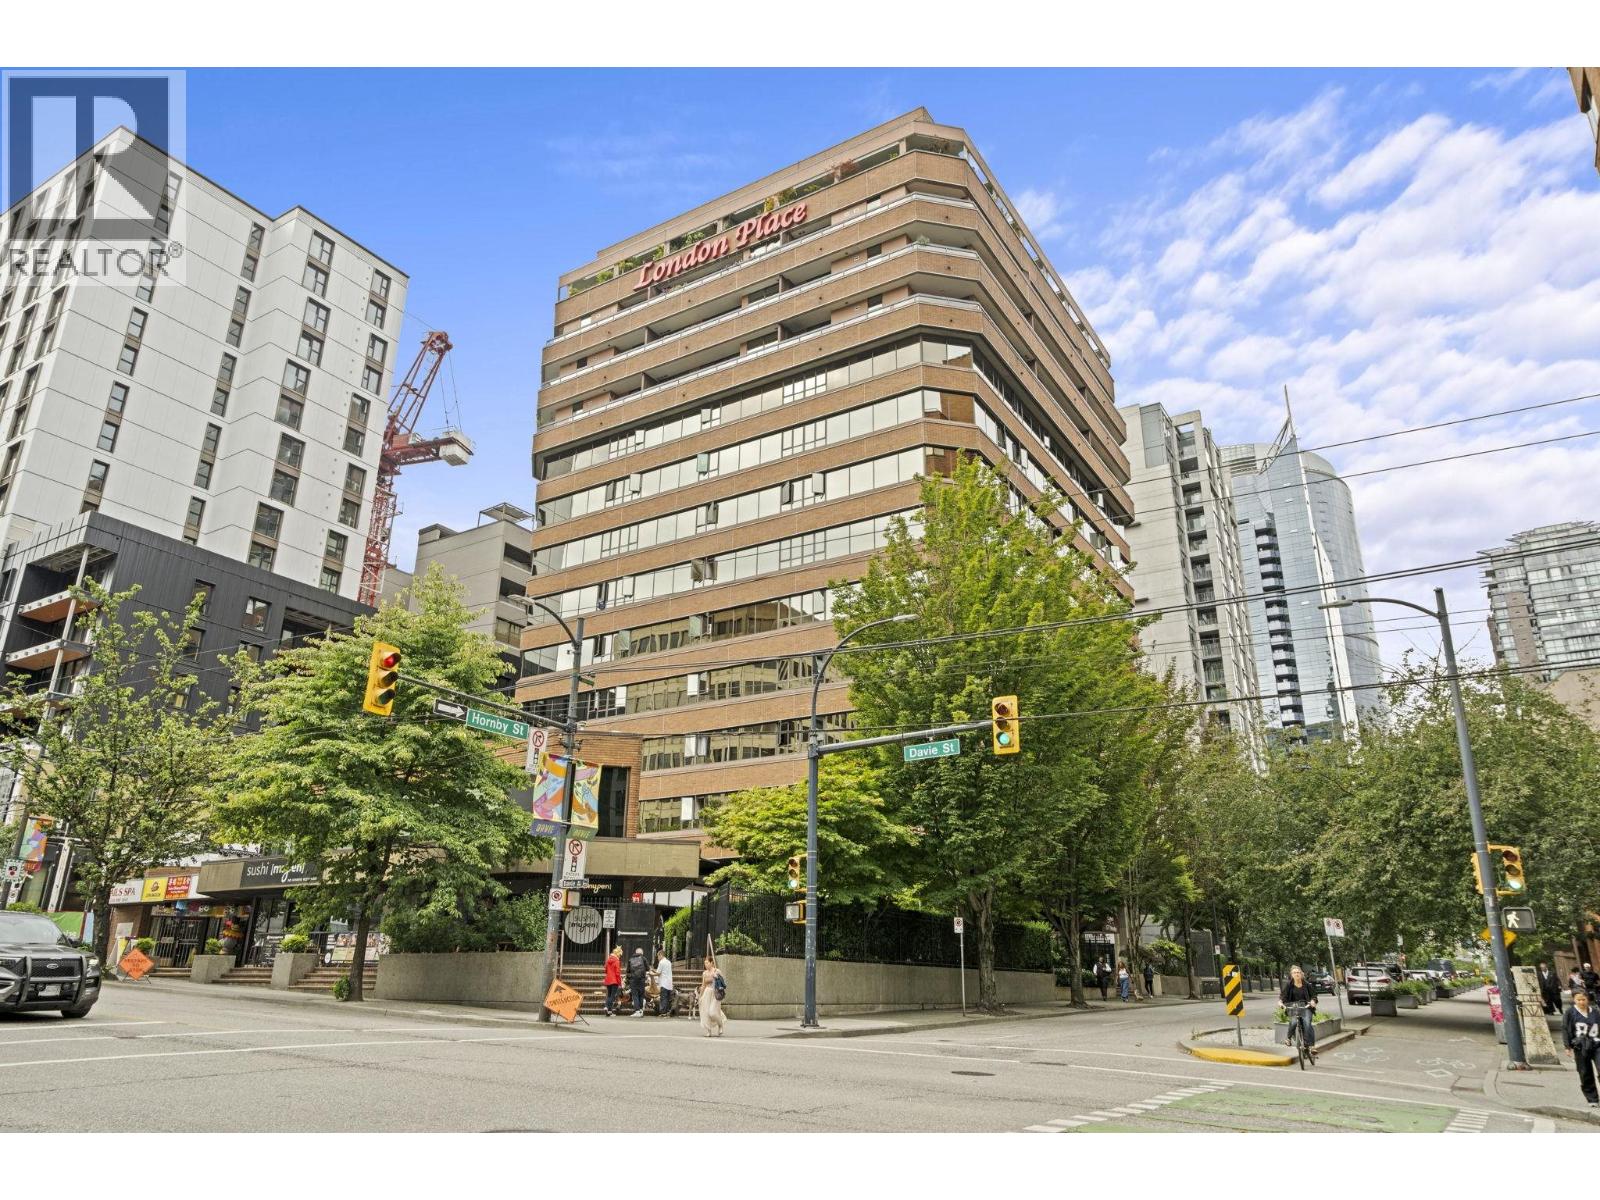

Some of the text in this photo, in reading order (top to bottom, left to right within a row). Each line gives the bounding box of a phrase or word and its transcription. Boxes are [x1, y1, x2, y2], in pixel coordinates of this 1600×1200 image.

[633, 202, 808, 292] London Place
[471, 712, 524, 736] Hornby St
[909, 743, 955, 758] Davie St
[246, 861, 270, 876] sushi
